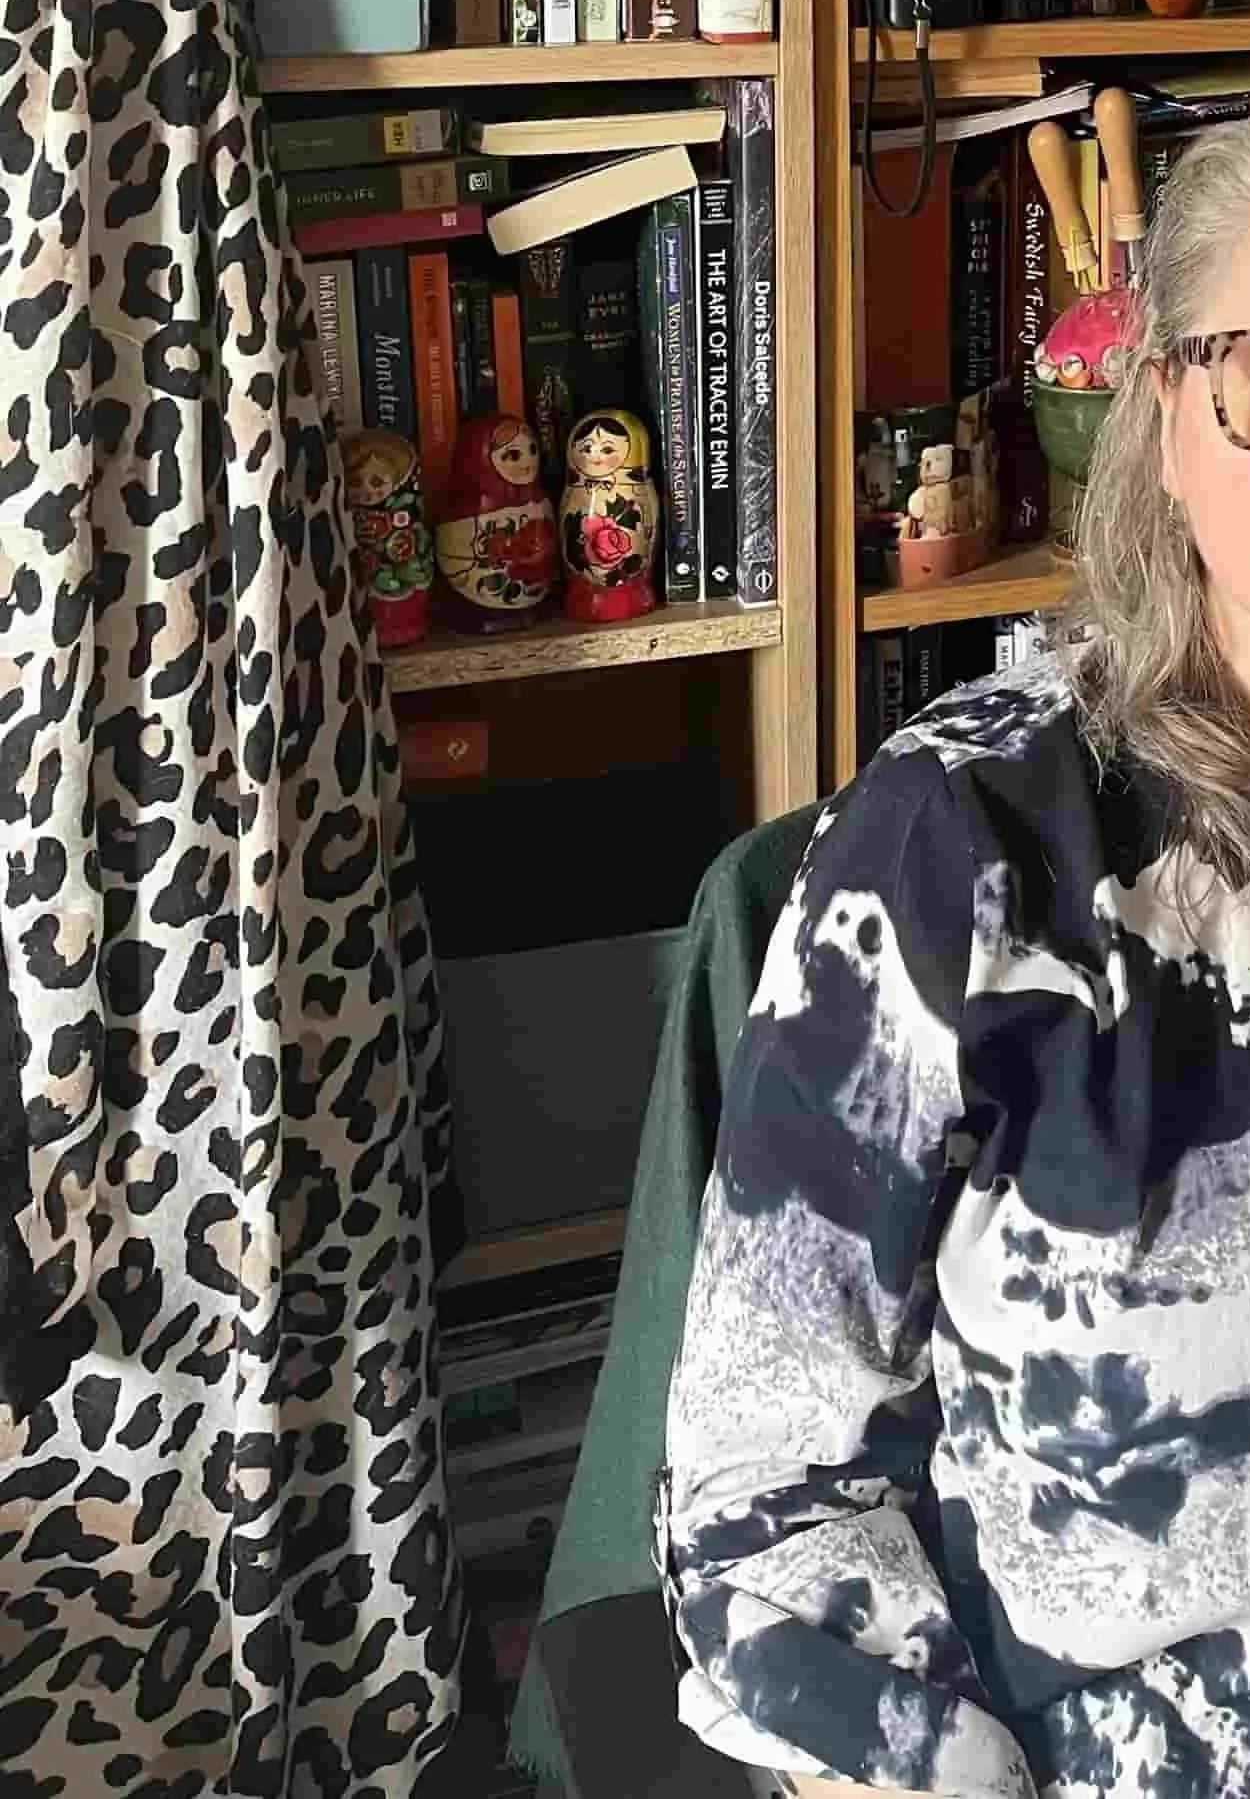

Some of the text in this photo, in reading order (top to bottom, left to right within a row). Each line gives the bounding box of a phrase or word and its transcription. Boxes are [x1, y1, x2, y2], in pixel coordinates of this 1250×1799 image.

[1023, 201, 1047, 282] Swedish
[666, 300, 684, 367] WOMEN
[754, 280, 772, 405] Doris Salcedo
[1020, 285, 1045, 347] Fairy
[706, 249, 729, 490] THE ART OF TRACEY EMIN
